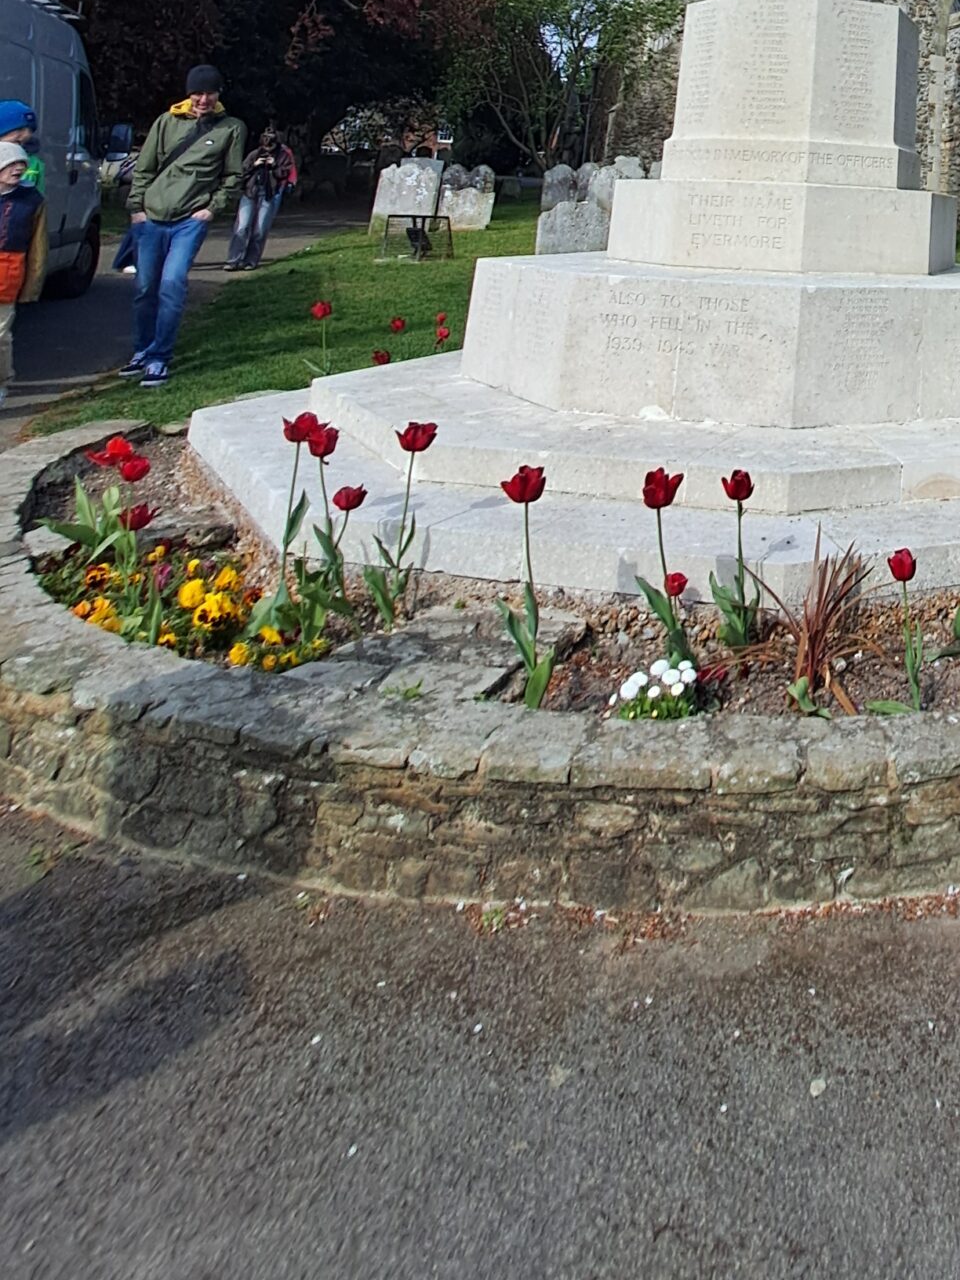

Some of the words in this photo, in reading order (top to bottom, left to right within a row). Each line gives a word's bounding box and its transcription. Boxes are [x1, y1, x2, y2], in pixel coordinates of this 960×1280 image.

[729, 148, 786, 162] MEMORY
[789, 151, 806, 164] OF
[808, 152, 832, 166] THE
[836, 154, 893, 169] OFFICERS
[687, 193, 735, 208] THEIR
[743, 196, 793, 211] NAME
[688, 213, 743, 227] LIVETH
[758, 215, 788, 229] FOR
[691, 232, 783, 250] EVERMORE
[608, 290, 646, 306] ALSO
[660, 294, 681, 309] TO
[698, 296, 750, 313] THOSE
[599, 313, 637, 329] WHO
[649, 316, 684, 332] FELL
[695, 319, 711, 334] IN
[724, 320, 755, 337] THE
[606, 334, 642, 352] 1939
[709, 340, 741, 358] WAR
